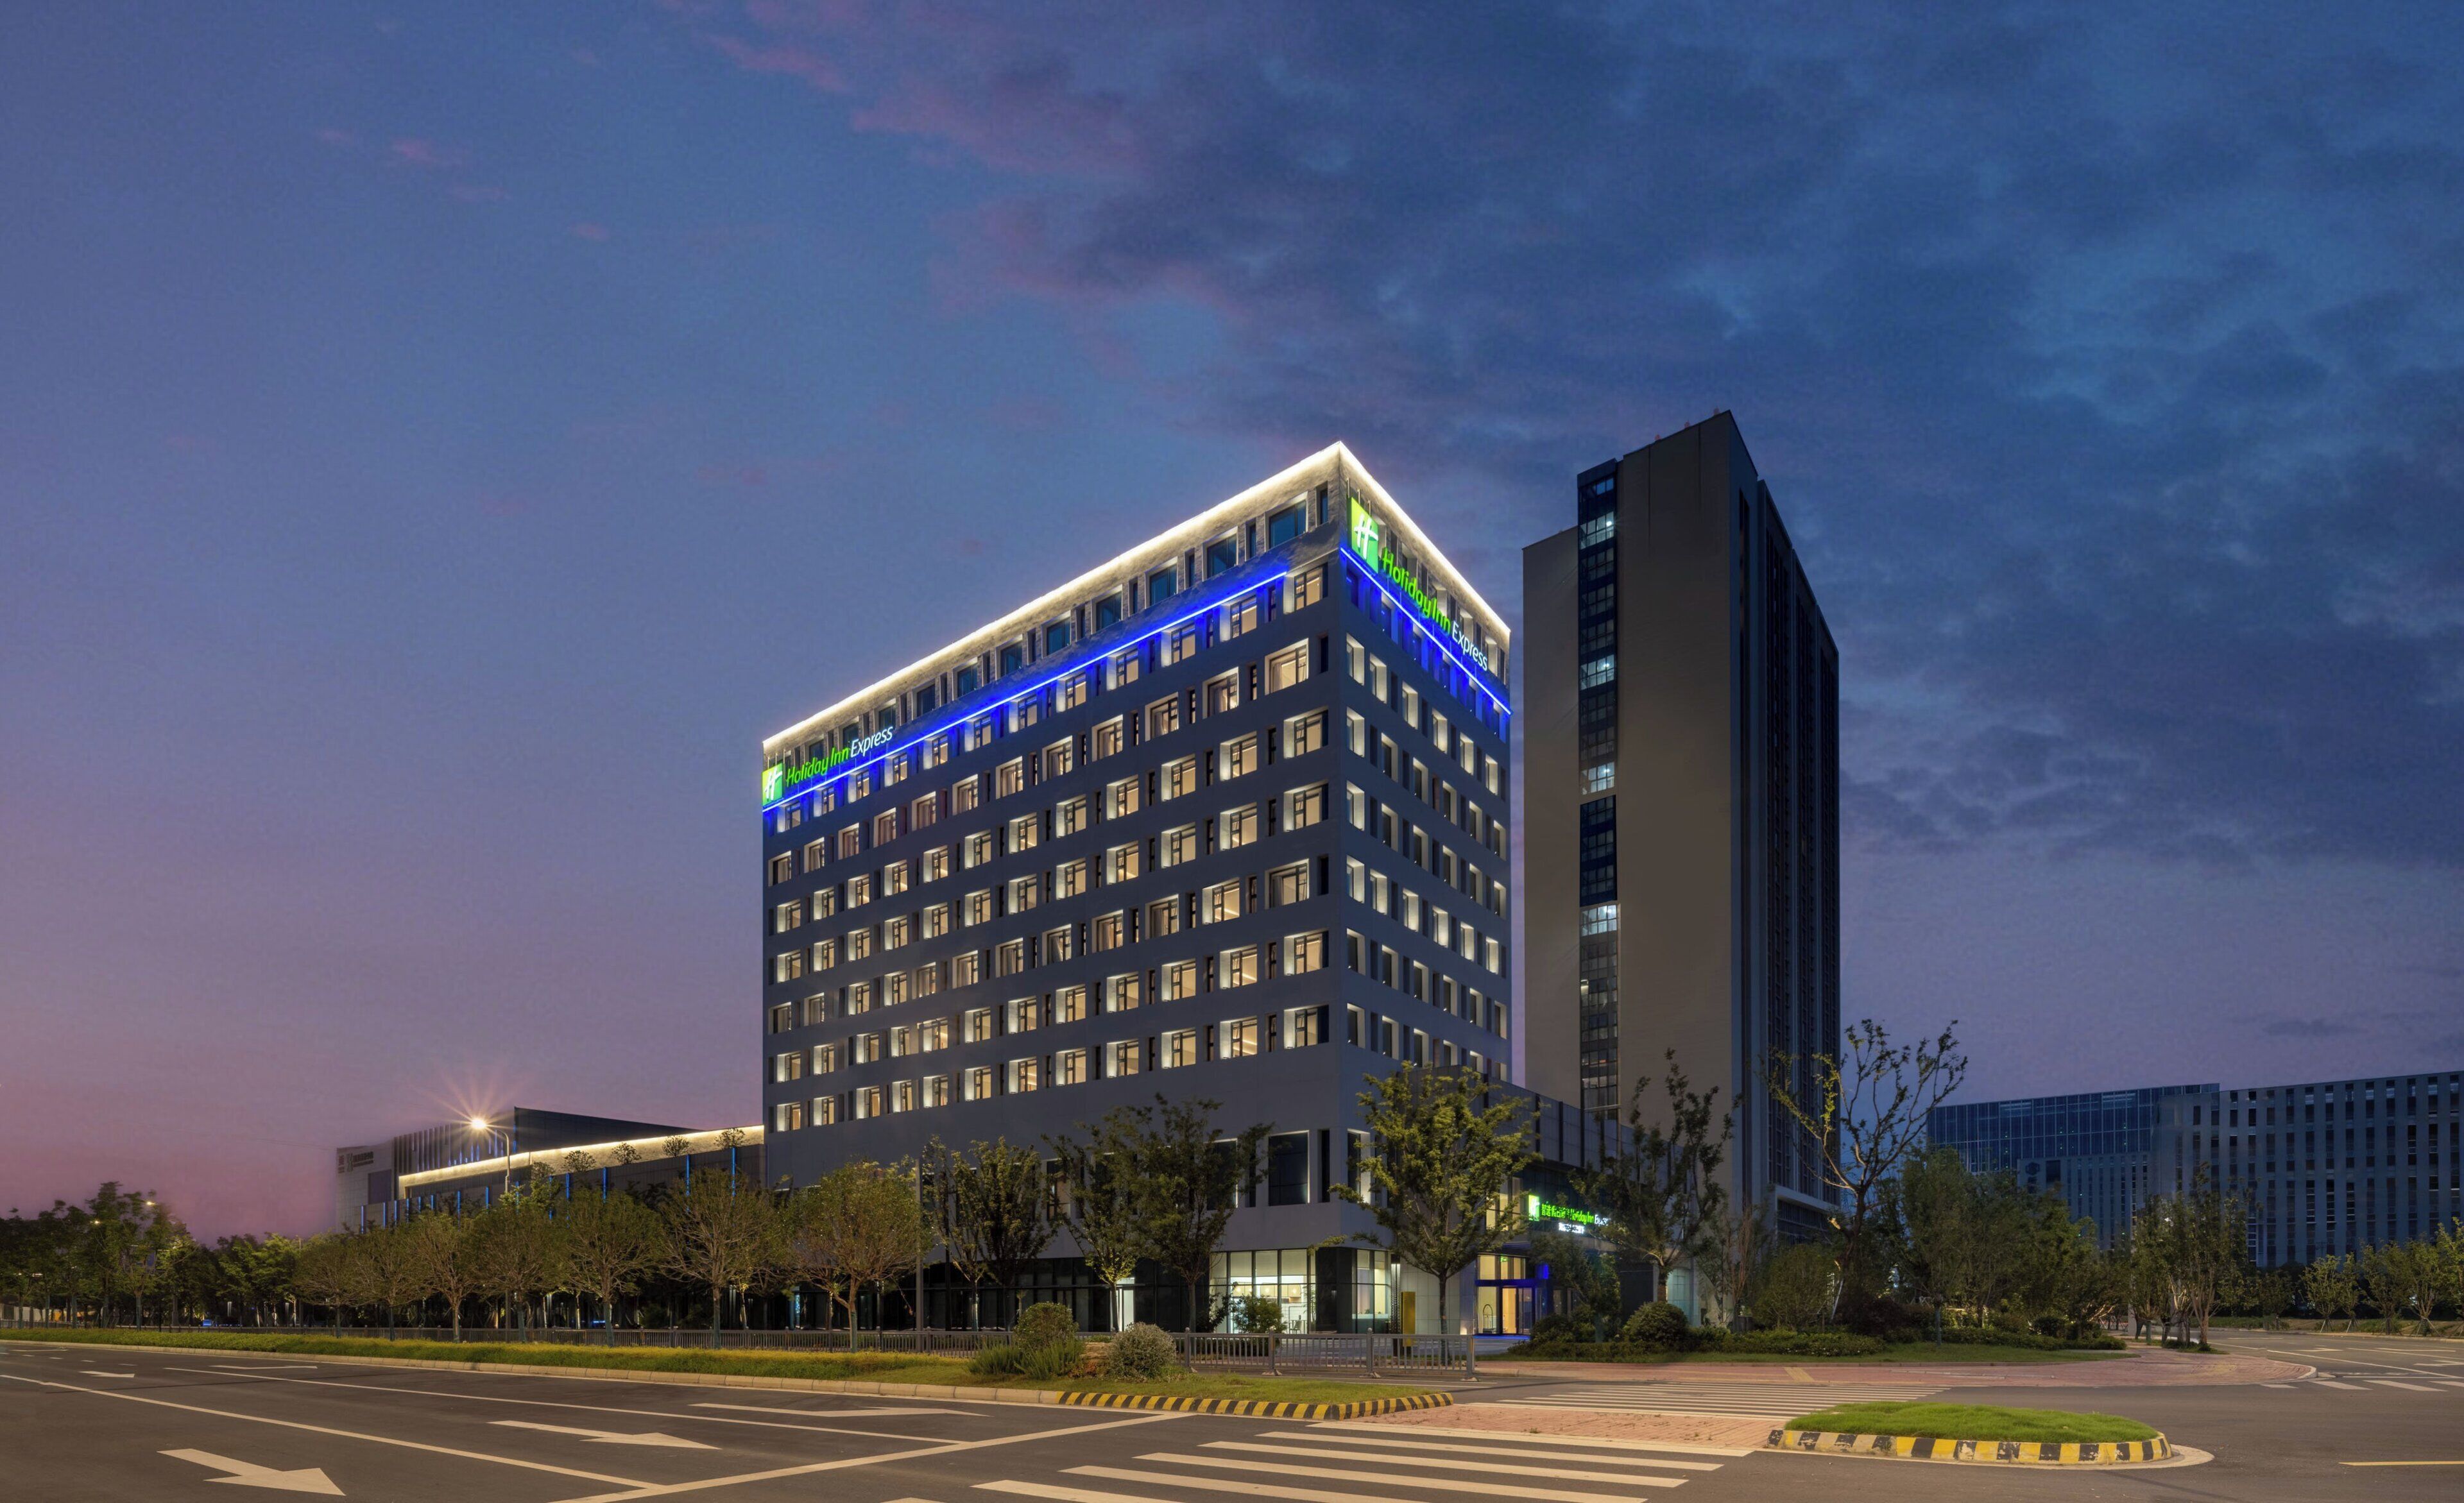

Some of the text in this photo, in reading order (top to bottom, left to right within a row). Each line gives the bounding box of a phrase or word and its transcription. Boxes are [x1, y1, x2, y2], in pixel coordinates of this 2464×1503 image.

[1382, 547, 1487, 672] Holiday Inn Express
[786, 726, 893, 786] Holiday Inn Express
[1541, 1202, 1570, 1218] 智选假日
